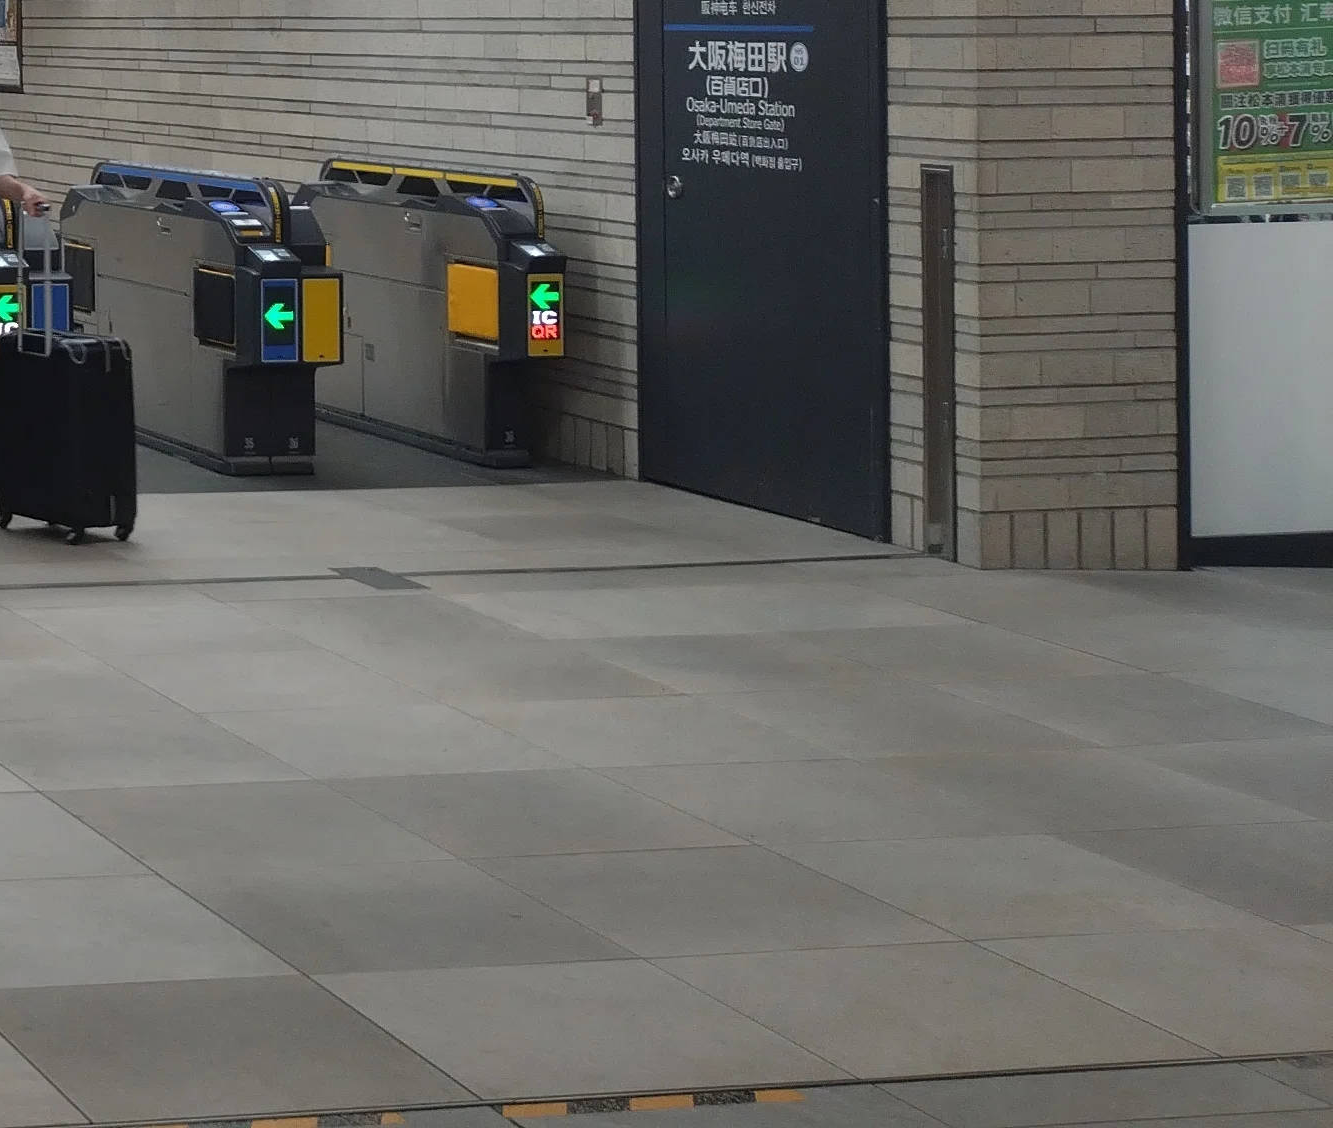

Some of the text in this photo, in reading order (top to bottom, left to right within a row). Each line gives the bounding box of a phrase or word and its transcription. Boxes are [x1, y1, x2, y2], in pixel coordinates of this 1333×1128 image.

[1214, 4, 1293, 27] 微信支付
[687, 40, 788, 73] 大阪梅田駅
[793, 56, 805, 66] 01
[686, 96, 795, 117] Osaka-Umeda Station
[681, 147, 709, 164] 오사카
[532, 310, 558, 324] IC
[531, 325, 558, 339] QR
